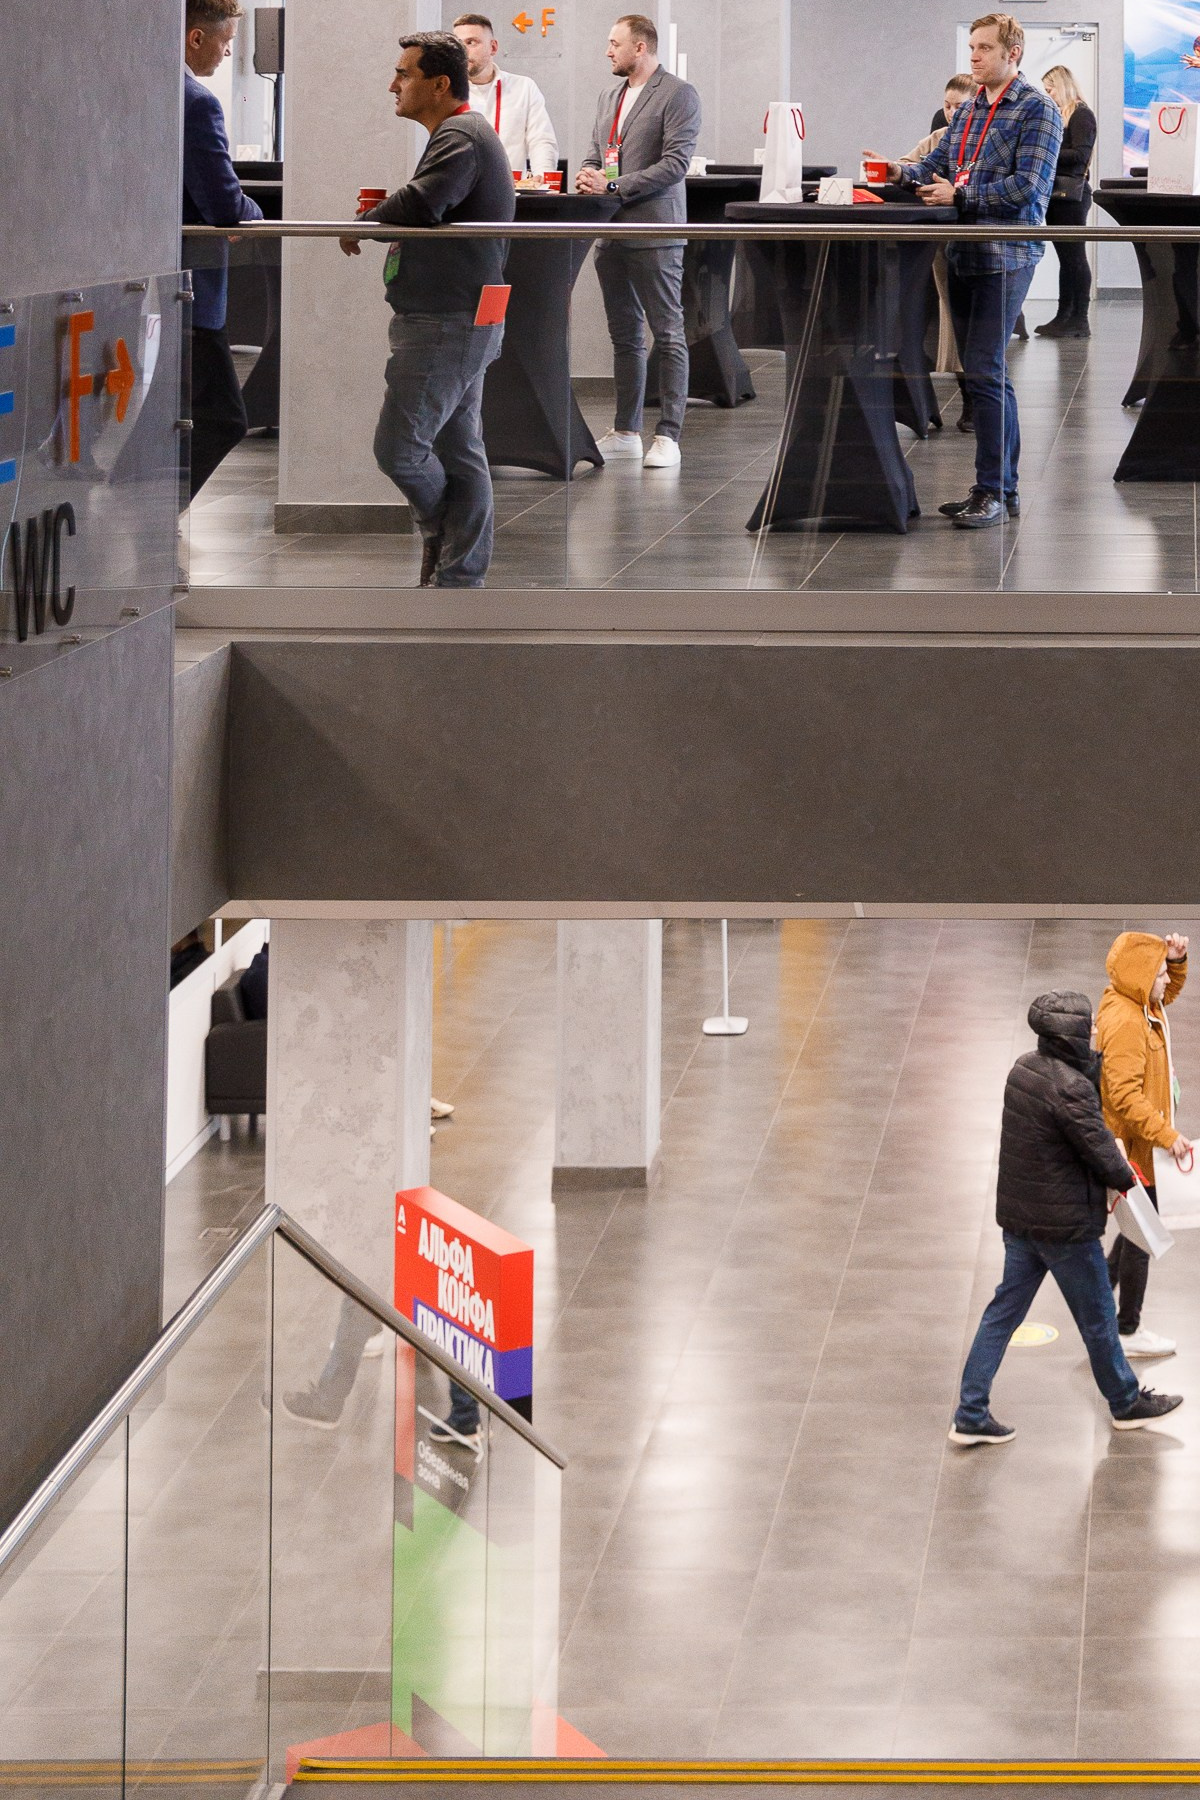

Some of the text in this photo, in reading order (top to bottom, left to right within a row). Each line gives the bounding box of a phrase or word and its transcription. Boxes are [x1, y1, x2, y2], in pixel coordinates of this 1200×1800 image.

[541, 8, 556, 38] F
[69, 310, 95, 464] F
[11, 501, 77, 643] WC
[418, 1217, 475, 1288] АЛЬФА
[437, 1268, 496, 1343] КОНФА
[416, 1303, 495, 1392] ПРАКТИКА
[417, 1439, 470, 1491] Обеденная
[417, 1463, 441, 1490] зона
